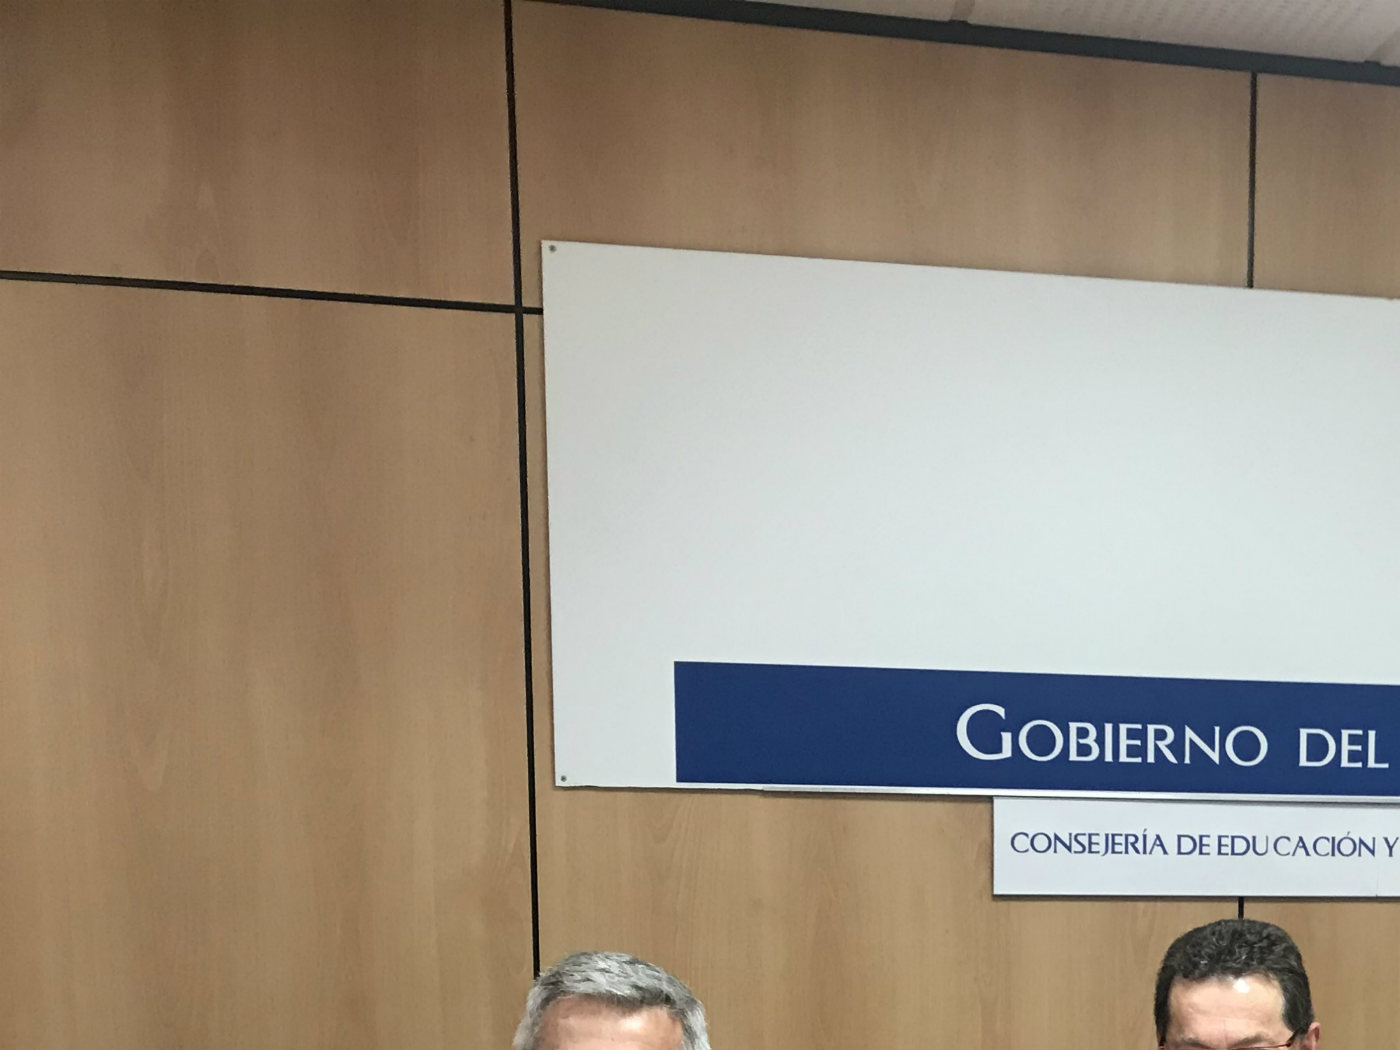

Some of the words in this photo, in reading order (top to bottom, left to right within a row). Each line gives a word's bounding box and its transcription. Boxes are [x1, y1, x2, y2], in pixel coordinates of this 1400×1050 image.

[956, 703, 1268, 767] GOBIERNO
[1298, 728, 1389, 769] DEL
[1010, 829, 1169, 857] CONSEJERÍA
[1176, 834, 1211, 856] DE
[1217, 831, 1377, 858] EDUCACIÓN
[1383, 836, 1399, 858] Y
